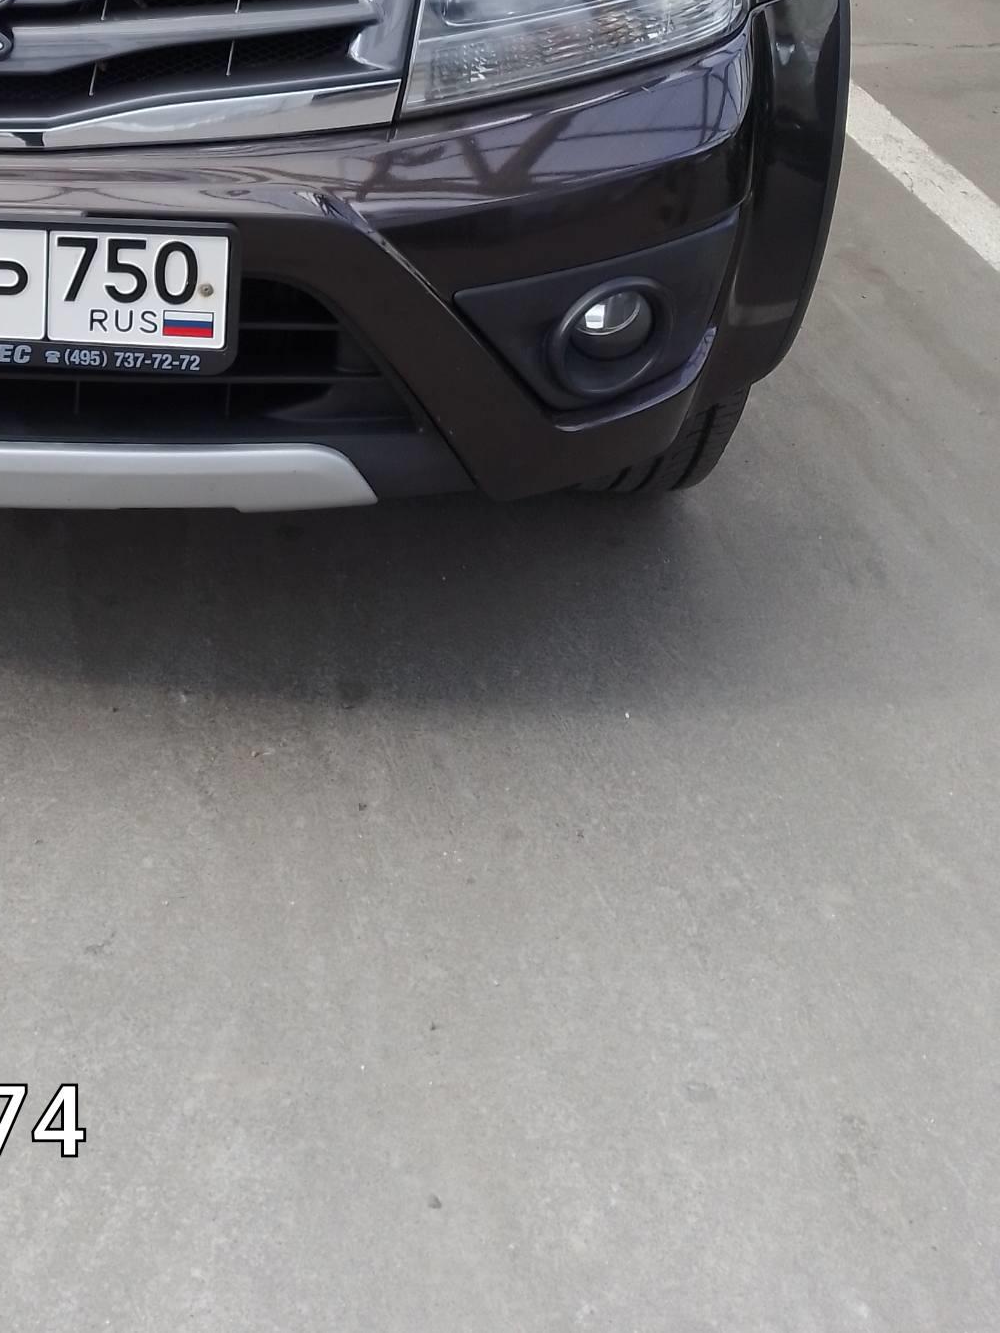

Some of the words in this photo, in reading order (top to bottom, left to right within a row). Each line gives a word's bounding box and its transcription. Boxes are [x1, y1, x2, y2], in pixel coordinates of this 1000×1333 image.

[56, 236, 198, 304] 750
[89, 309, 158, 335] RUS
[64, 349, 107, 368] (495)
[114, 351, 201, 371] 737-72-72
